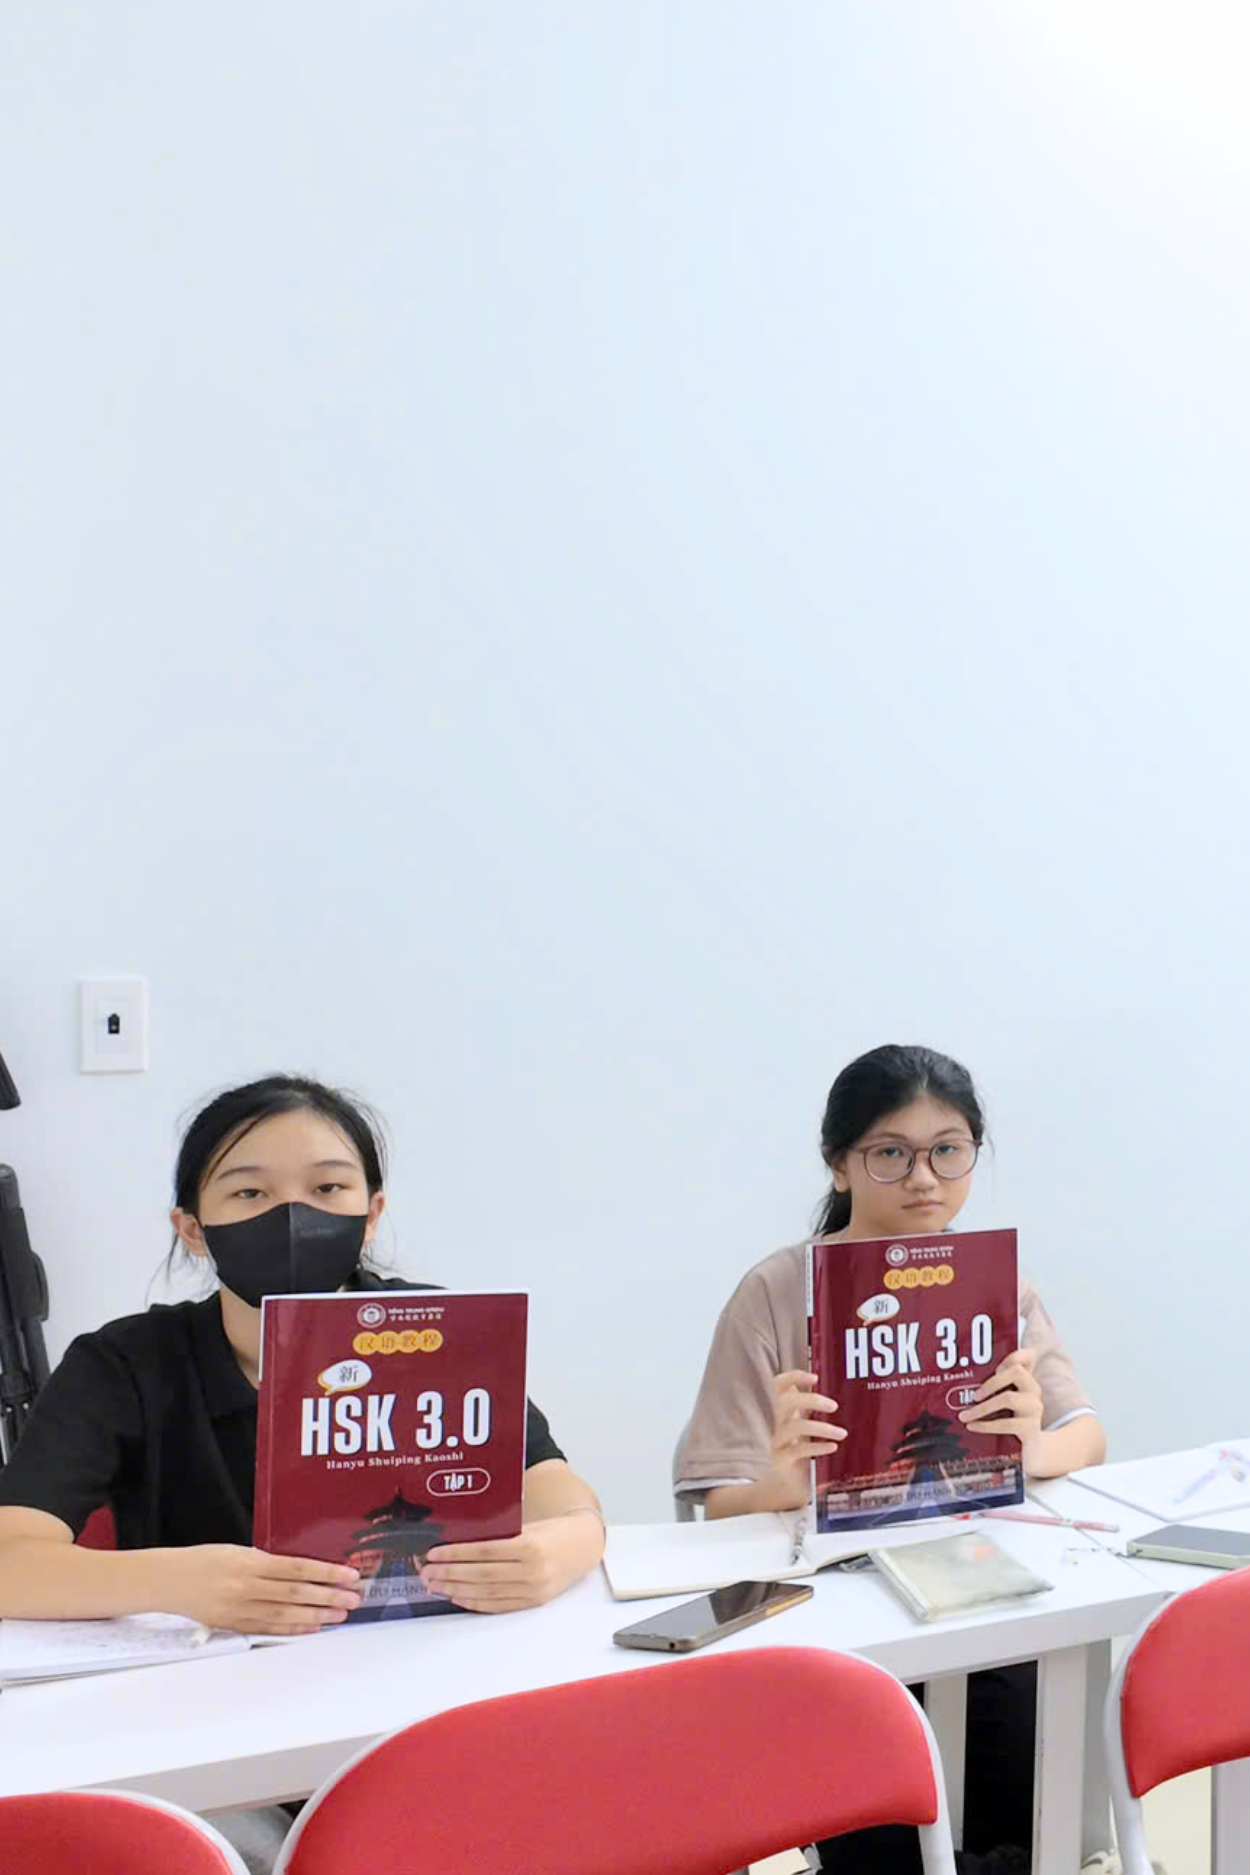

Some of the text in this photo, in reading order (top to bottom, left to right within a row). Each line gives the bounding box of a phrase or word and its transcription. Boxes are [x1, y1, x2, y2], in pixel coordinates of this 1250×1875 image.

[845, 1313, 993, 1379] HSK 3.0
[338, 1363, 360, 1385] 新
[867, 1379, 898, 1391] Hanyu
[900, 1374, 942, 1388] Shuiping
[301, 1388, 491, 1456] HSK 3.0
[326, 1451, 463, 1470] Hanyu Shuiping Kaoshi
[444, 1472, 473, 1492] TẬP 1
